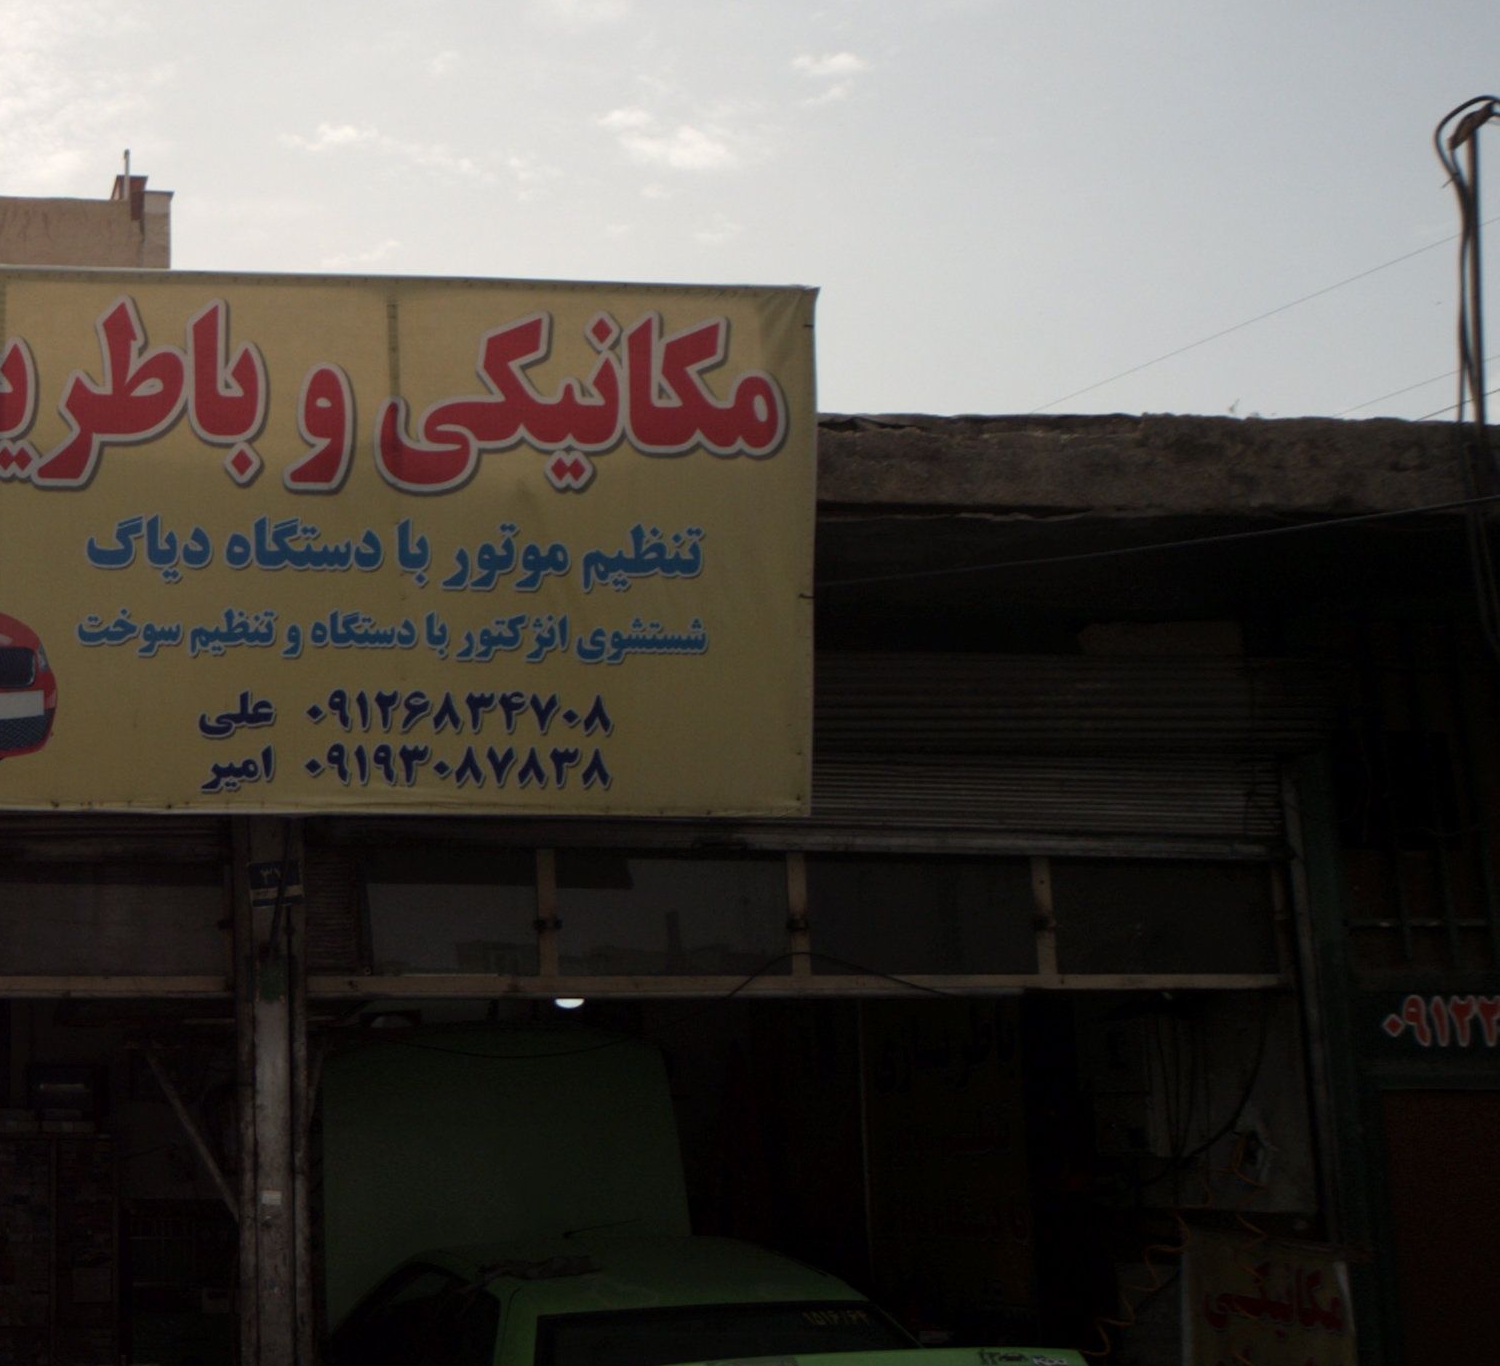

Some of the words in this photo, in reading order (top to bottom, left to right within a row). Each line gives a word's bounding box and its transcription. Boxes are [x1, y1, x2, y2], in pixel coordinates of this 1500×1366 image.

[283, 361, 355, 493] و
[375, 311, 788, 495] مکانیکی
[86, 513, 214, 583] دیاگ
[224, 515, 384, 572] دستگاه
[396, 517, 431, 586] با
[442, 522, 570, 591] موتور
[581, 523, 705, 592] تنظیم
[76, 607, 184, 658] سوخت
[188, 607, 278, 658] تنظیم
[280, 621, 304, 659] و
[310, 610, 417, 650] دستگاه
[424, 611, 450, 659] با
[454, 613, 570, 663] انژکتور
[576, 617, 709, 665] شستشوی
[198, 689, 276, 739] علی
[200, 744, 275, 794] امیر
